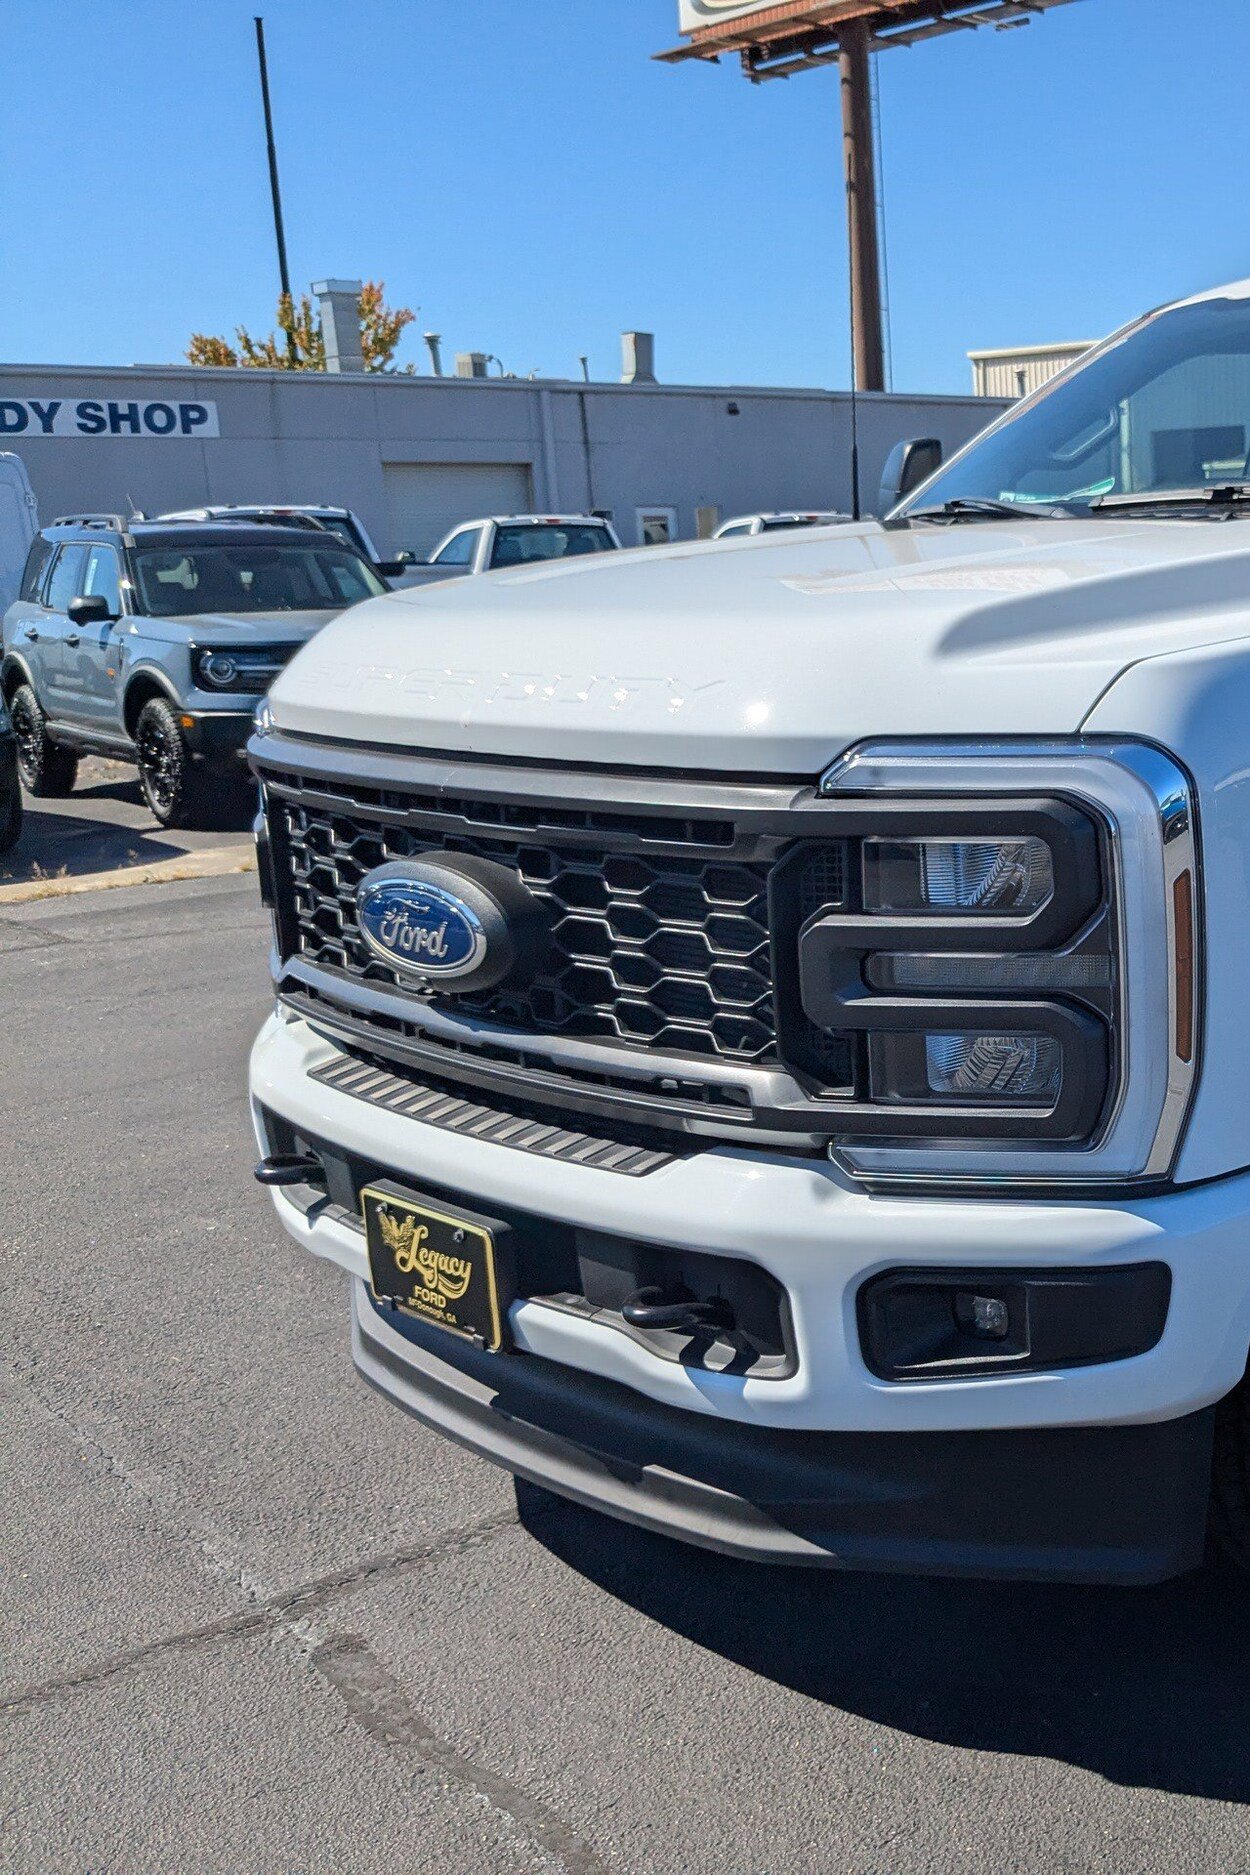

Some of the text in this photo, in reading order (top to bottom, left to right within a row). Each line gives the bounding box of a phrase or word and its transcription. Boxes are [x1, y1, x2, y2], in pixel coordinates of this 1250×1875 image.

[76, 401, 208, 434] SHOP
[484, 672, 726, 712] DUTY
[379, 898, 449, 958] Ford
[395, 1225, 472, 1300] Legacy
[414, 1285, 447, 1309] FORD
